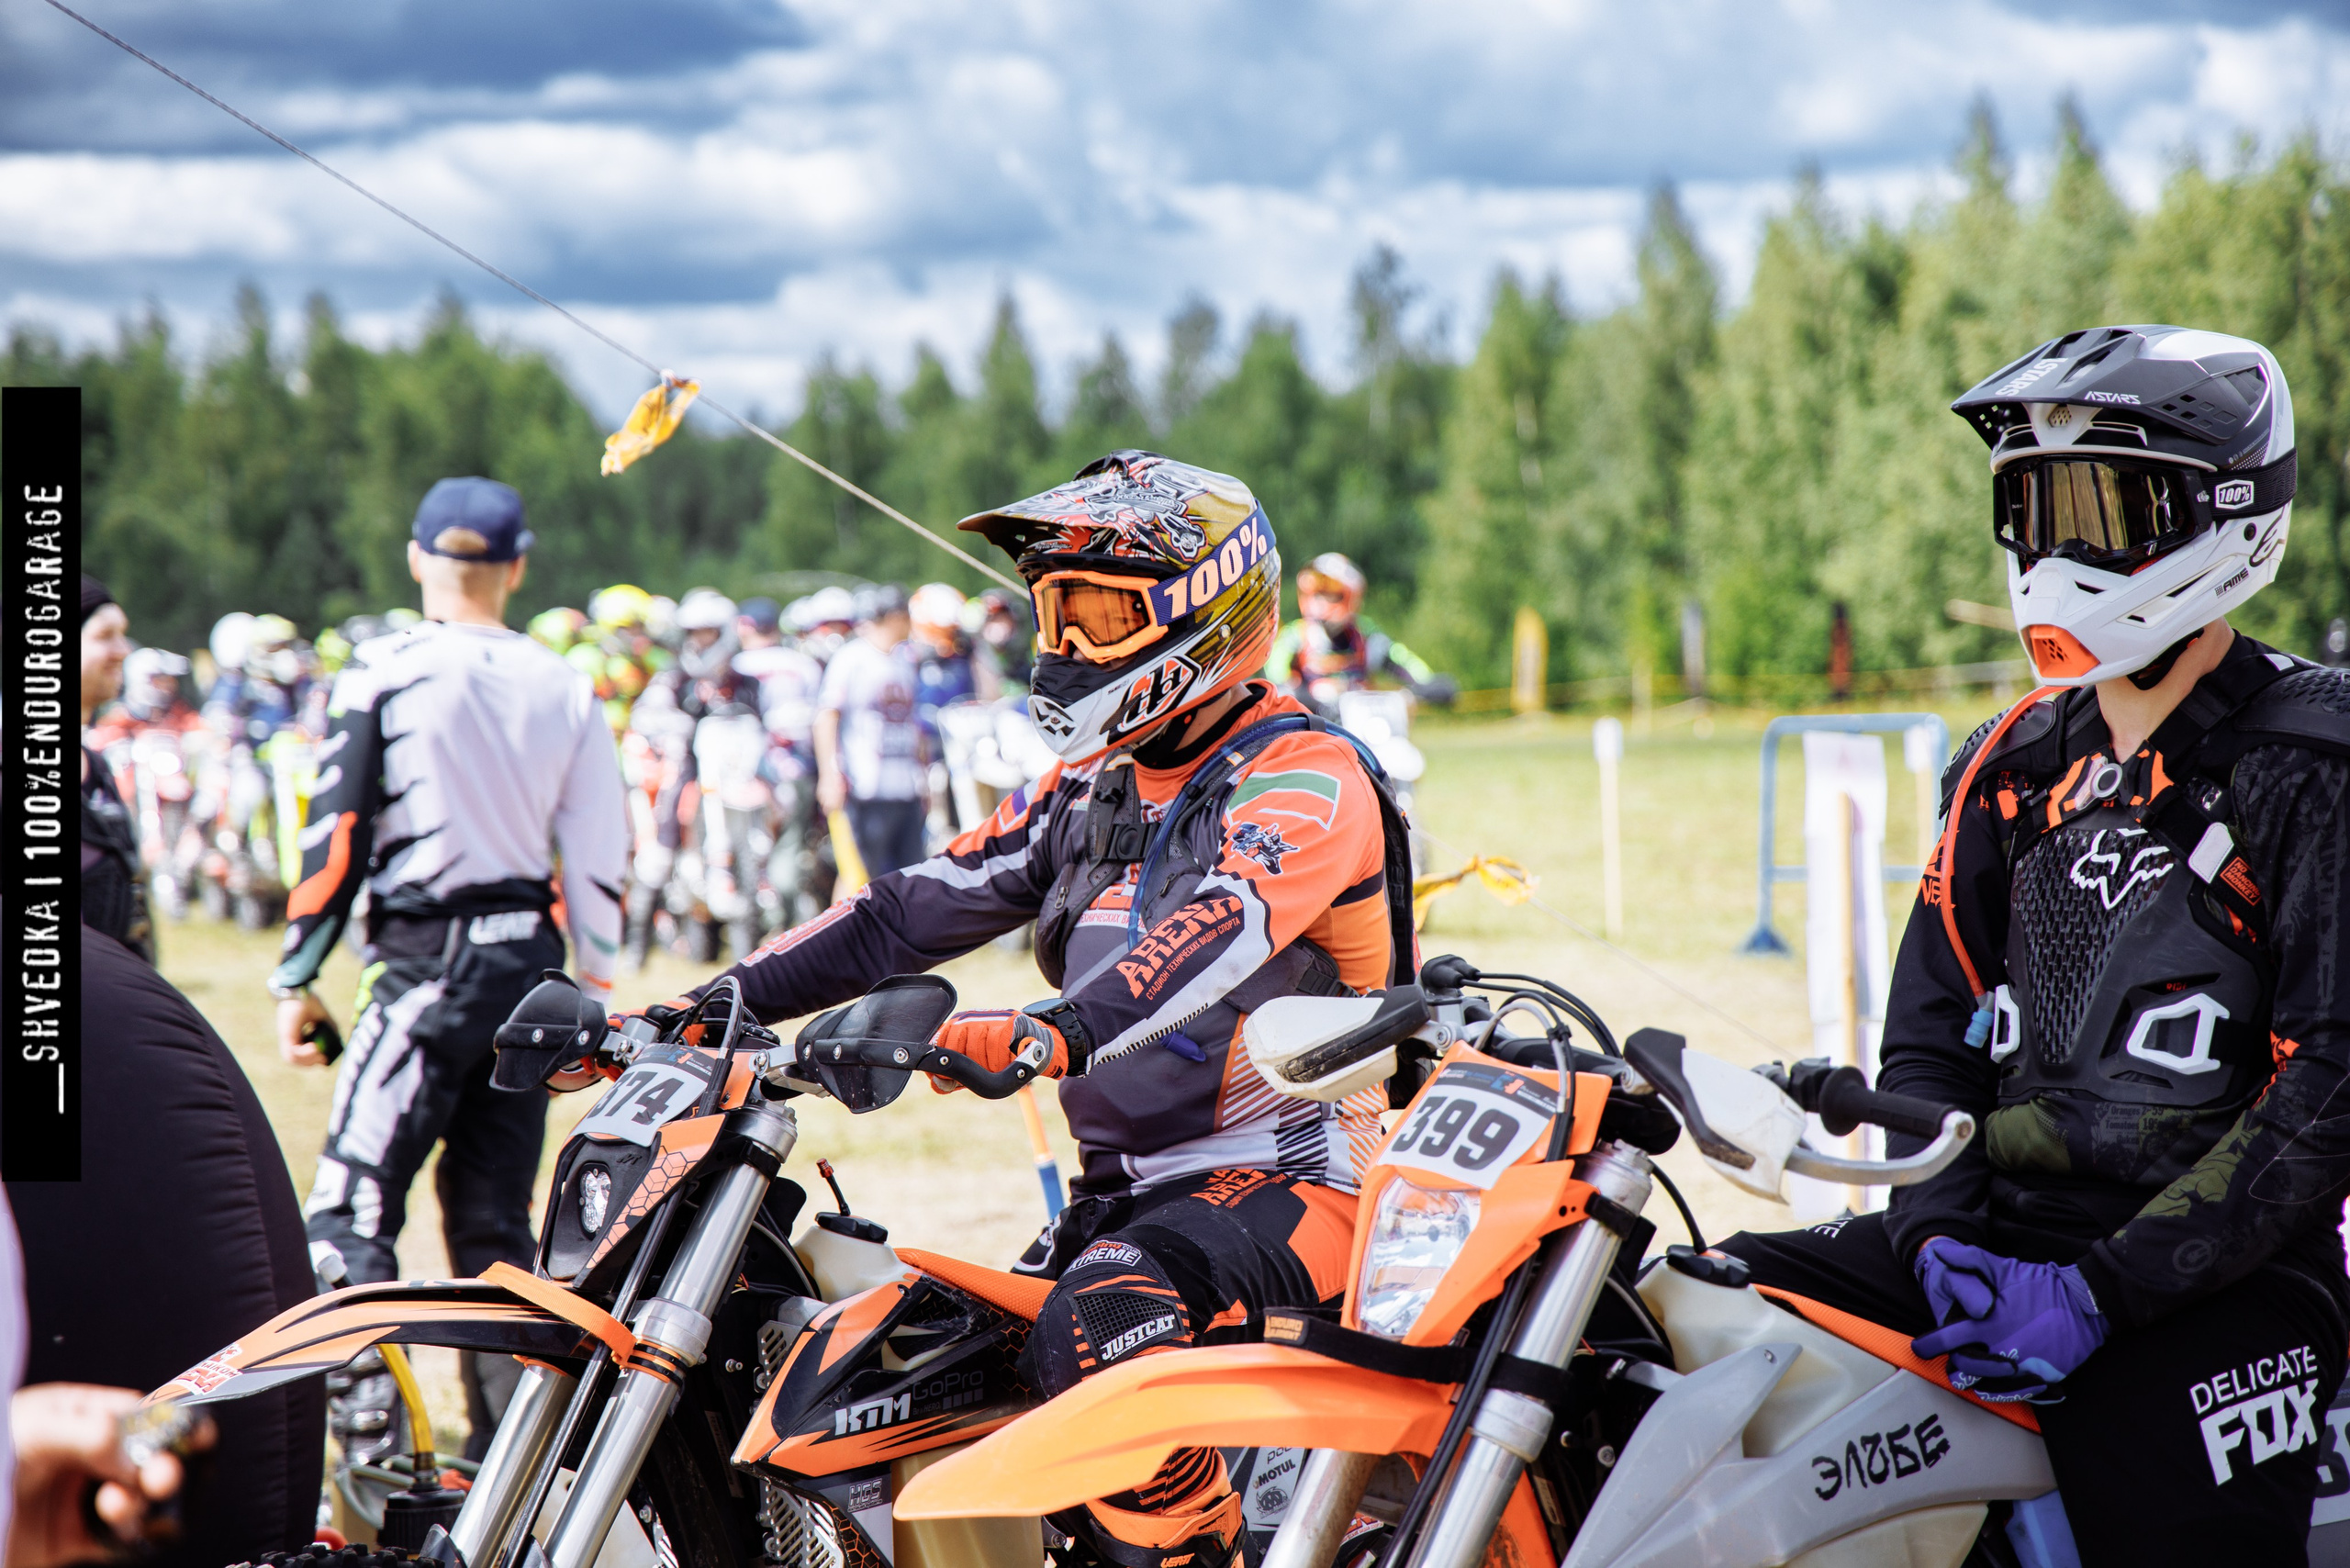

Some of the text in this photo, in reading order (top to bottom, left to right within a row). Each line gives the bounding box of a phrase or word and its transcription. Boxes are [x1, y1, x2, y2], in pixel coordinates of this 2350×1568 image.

[2220, 487, 2251, 504] 100%
[1164, 517, 1269, 619] 100%
[2230, 867, 2260, 896] DANCING
[2234, 862, 2248, 873] NO
[2224, 871, 2257, 899] MONKEY
[1116, 895, 1244, 1000] ARENA
[1146, 916, 1241, 1001] СТАДИОН ТЕХНИЧЕСКИХ ВИДОВ СПОРТА
[2105, 1119, 2140, 1130] Tomatoes
[2111, 1105, 2141, 1116] Oranges
[1392, 1095, 1520, 1171] 399
[1100, 1314, 1176, 1361] JUSTCAT
[912, 1370, 984, 1401] GoPro
[2189, 1346, 2318, 1415] DELICATE
[834, 1392, 912, 1437] KTM
[2199, 1378, 2319, 1486] FOX
[1258, 1459, 1296, 1486] MOTUL
[849, 1478, 882, 1507] HGS
